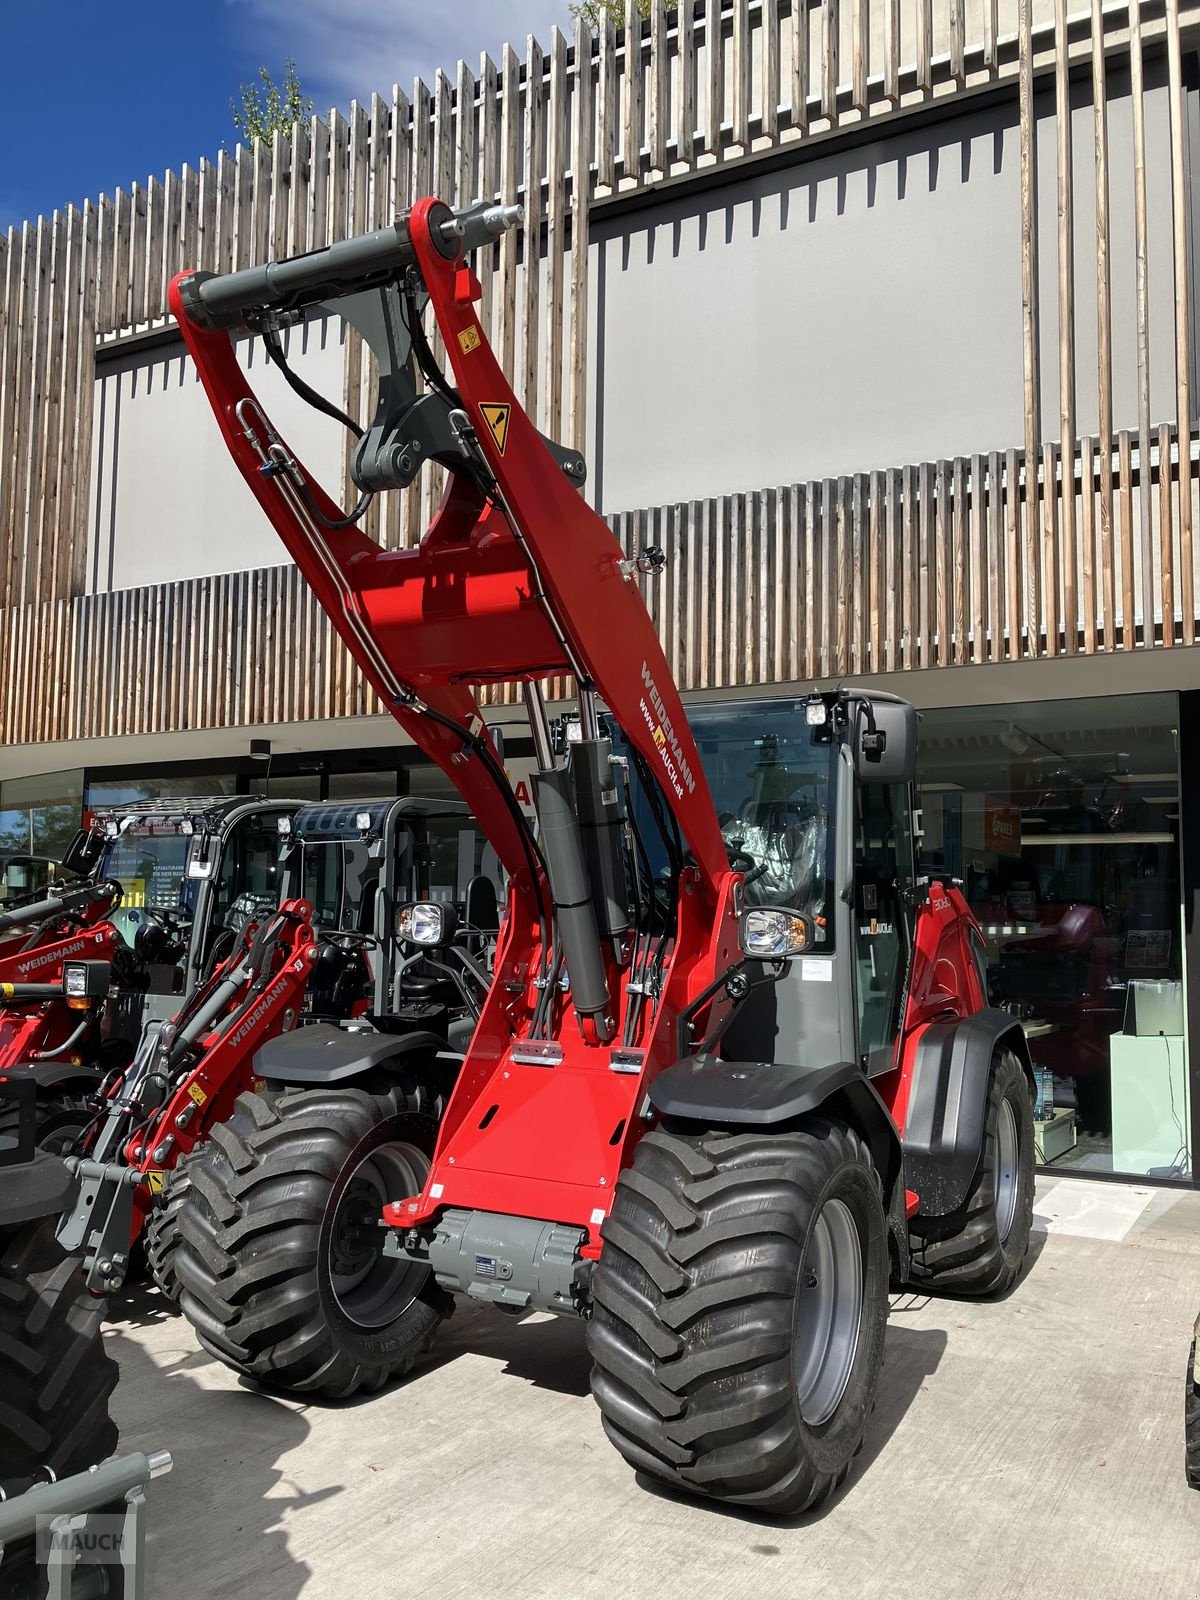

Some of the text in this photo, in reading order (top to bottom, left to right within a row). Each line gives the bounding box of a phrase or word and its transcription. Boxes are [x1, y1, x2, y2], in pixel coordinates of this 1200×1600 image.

[639, 698, 684, 799] www.MAUCH.at
[641, 659, 696, 794] WEIDEMANN
[18, 940, 86, 973] WEIDEMANN
[229, 978, 289, 1047] WEIDEMANN
